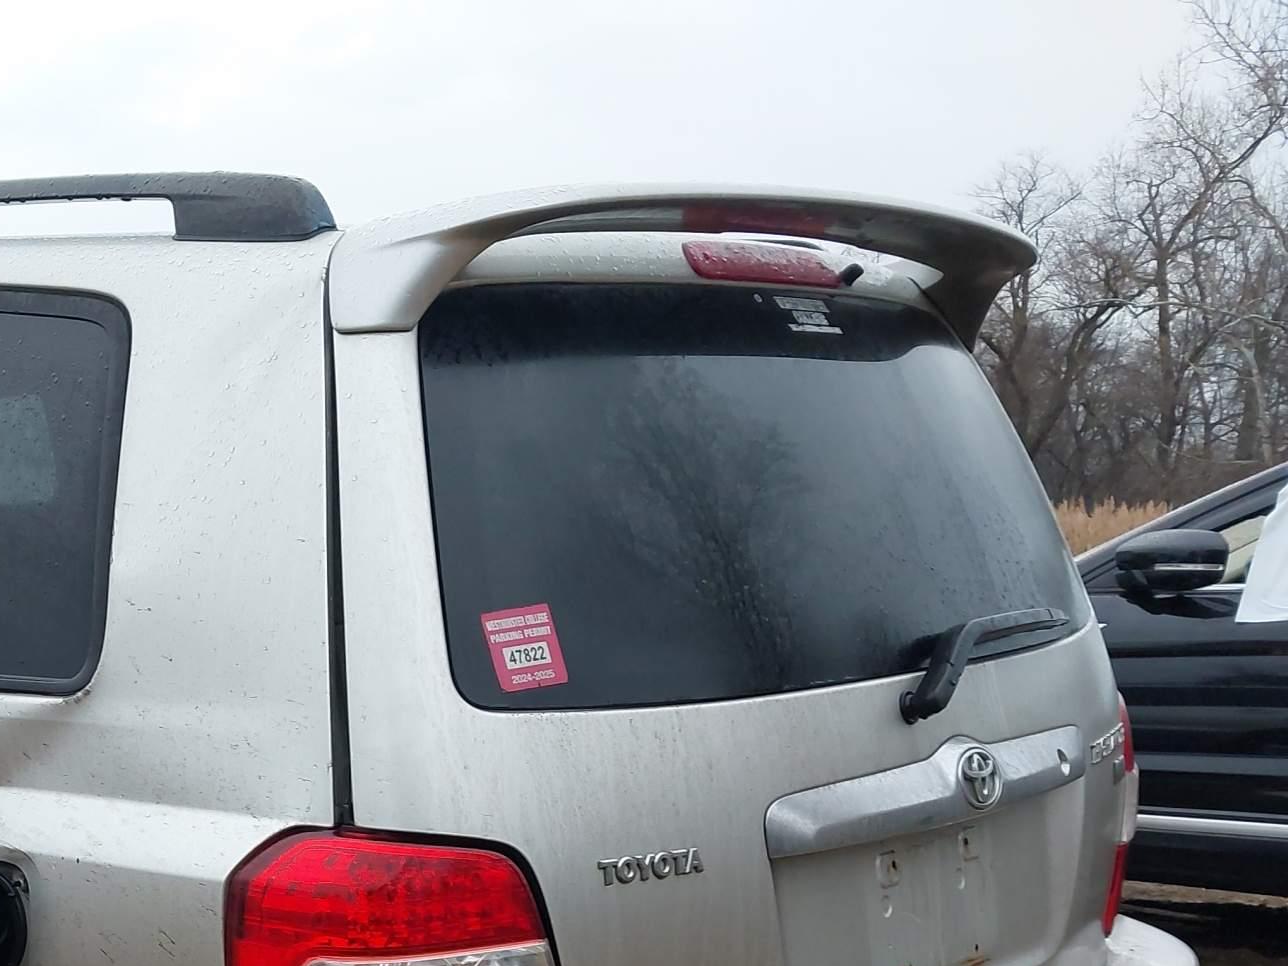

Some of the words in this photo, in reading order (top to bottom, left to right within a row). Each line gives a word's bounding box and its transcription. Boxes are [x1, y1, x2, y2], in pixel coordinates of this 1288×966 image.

[490, 630, 524, 644] PARKING
[524, 626, 551, 638] PERMIT
[509, 645, 547, 665] 47822
[512, 669, 555, 684] 2024-2025
[598, 847, 704, 886] TOYOTA
